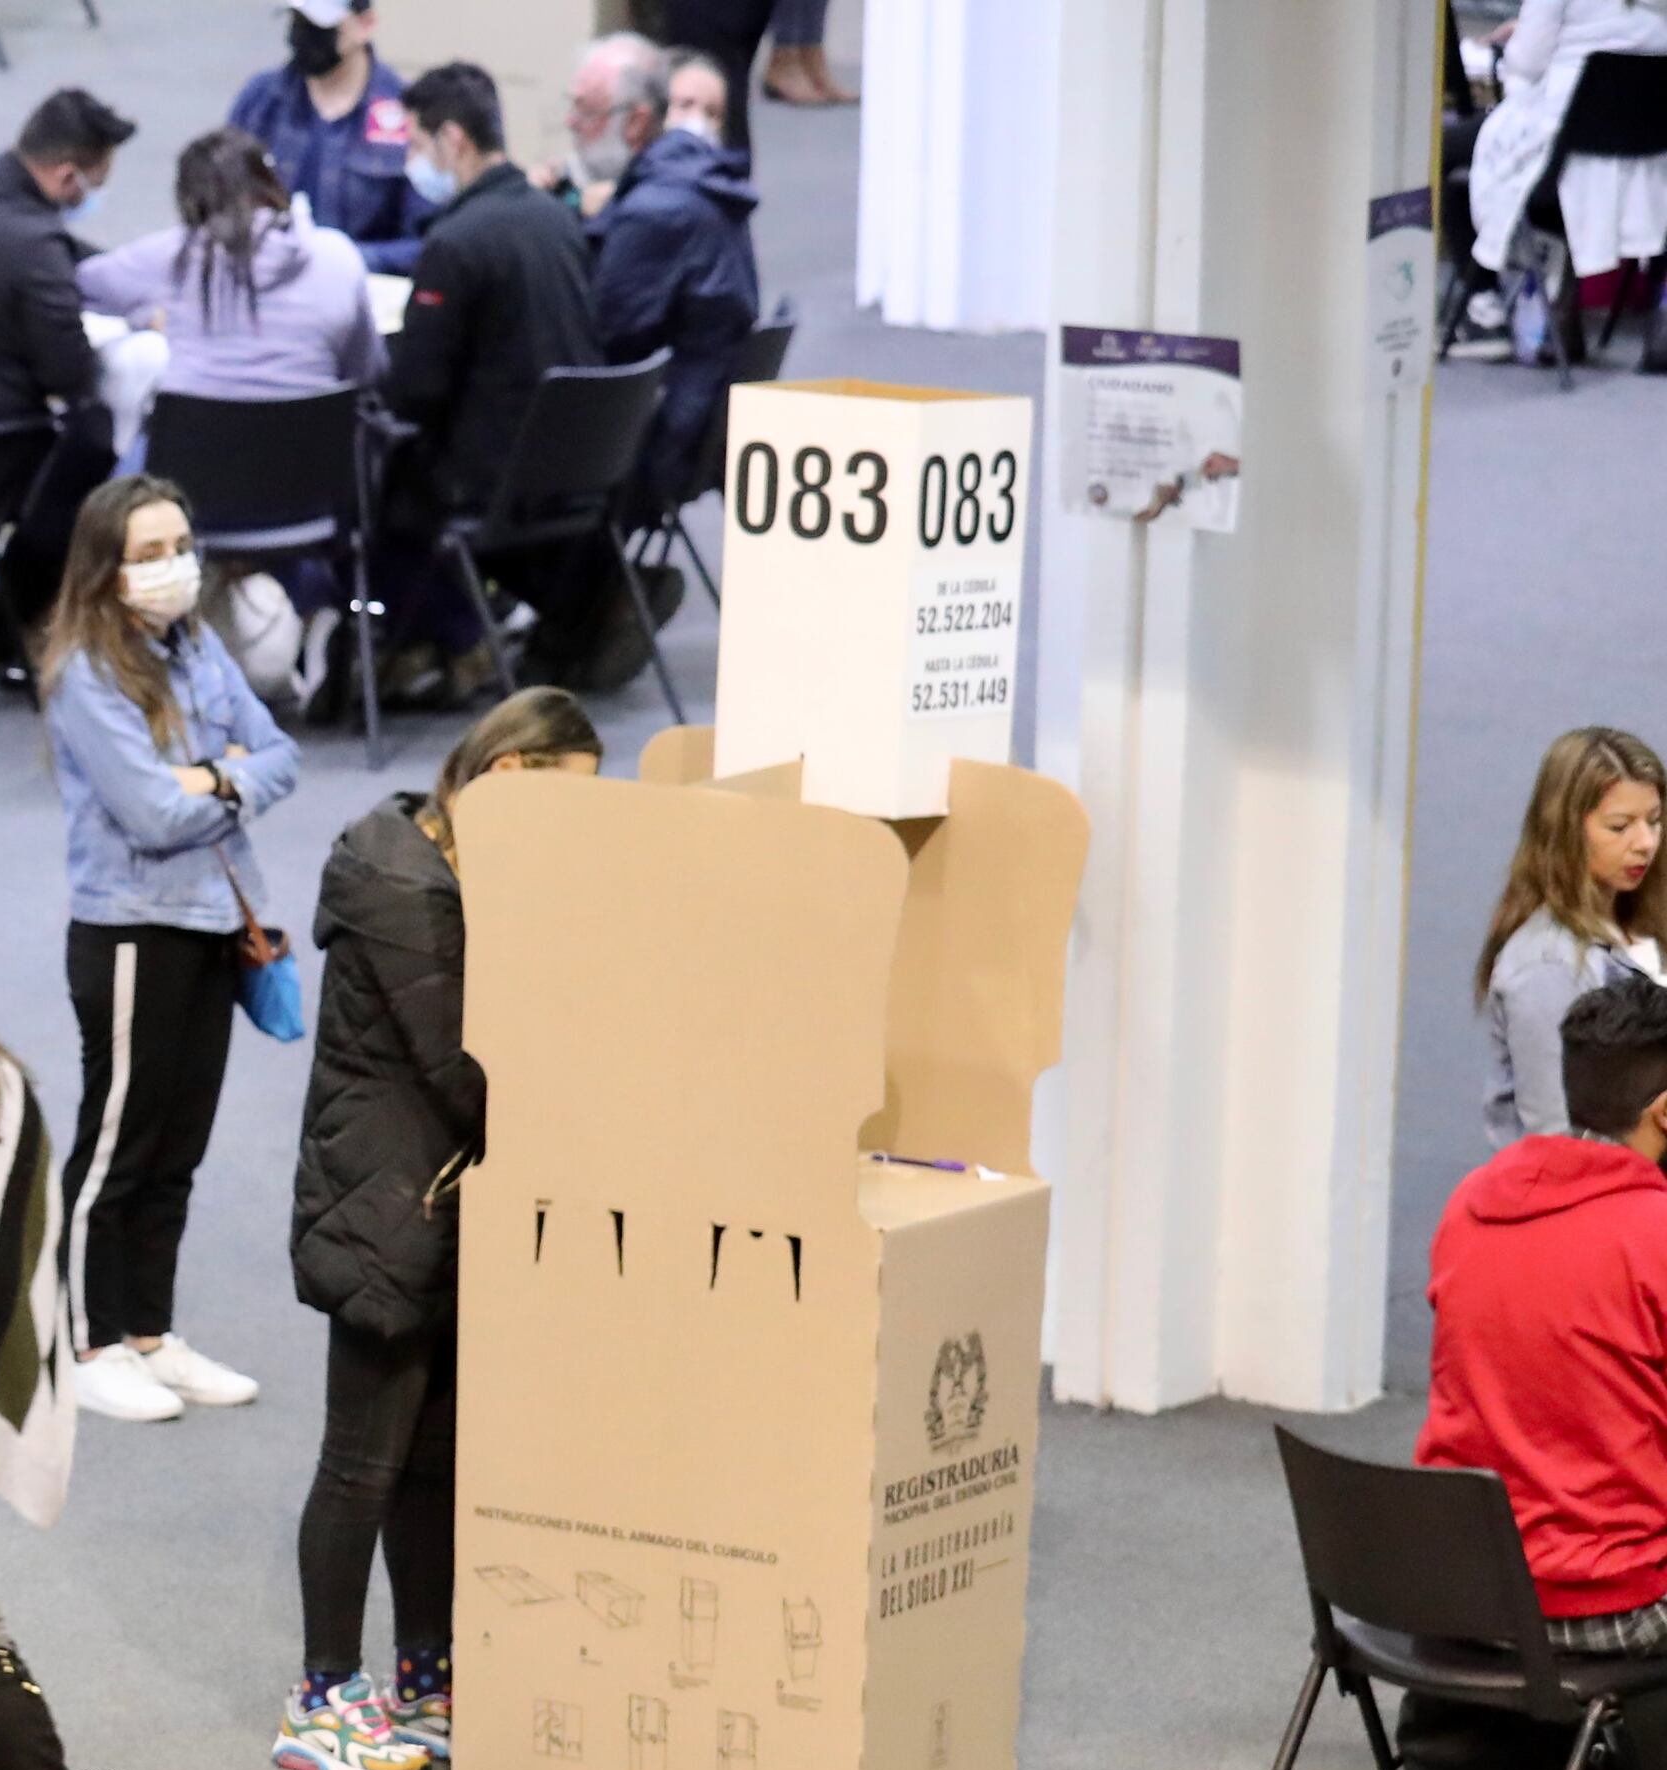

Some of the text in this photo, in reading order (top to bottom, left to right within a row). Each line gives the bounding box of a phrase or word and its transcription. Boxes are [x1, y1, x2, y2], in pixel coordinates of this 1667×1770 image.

[735, 441, 889, 545] 083
[919, 449, 1017, 549] 083
[916, 601, 1012, 635] 52.522.204
[912, 676, 1008, 712] 52.531.449
[924, 656, 951, 673] HASTA
[884, 1437, 1020, 1508] REGISTRADURÍA
[473, 1504, 779, 1566] INSTRUCCIONES PARA EL ARMADO DEL CUBICULO
[881, 1509, 1014, 1579] LA REGISTRADURÍA
[880, 1557, 975, 1619] DEL SIGLO XXI
